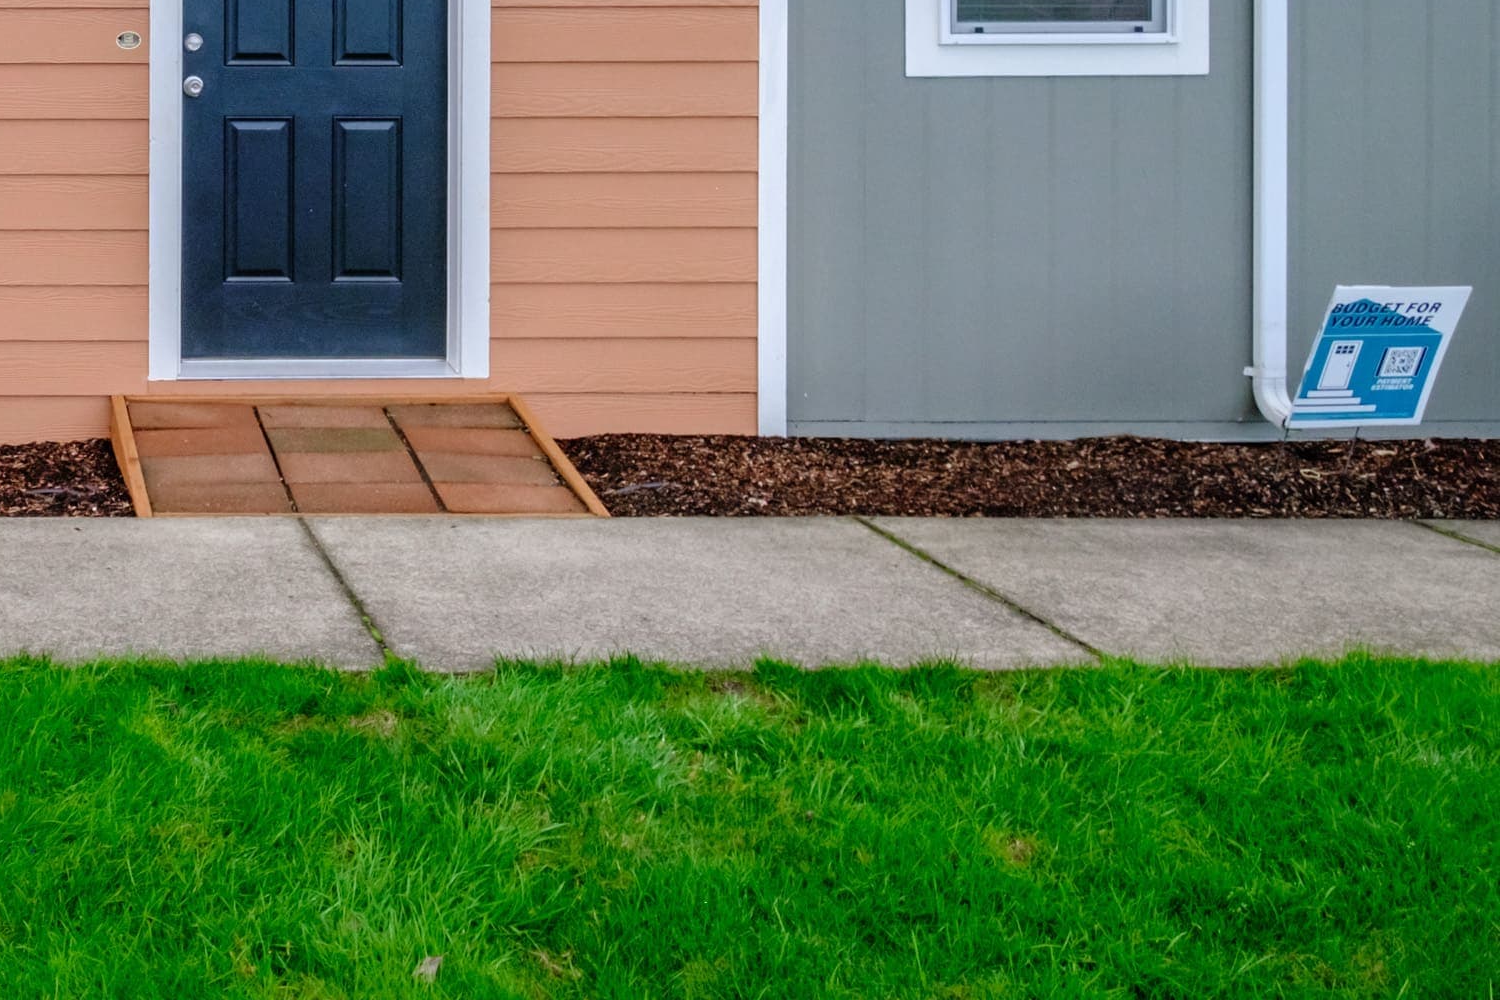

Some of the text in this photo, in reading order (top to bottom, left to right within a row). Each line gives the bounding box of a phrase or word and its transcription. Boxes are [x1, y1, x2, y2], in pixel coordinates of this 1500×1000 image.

[1331, 302, 1442, 313] BUDGET FOR
[1332, 315, 1435, 327] YOUR HOME
